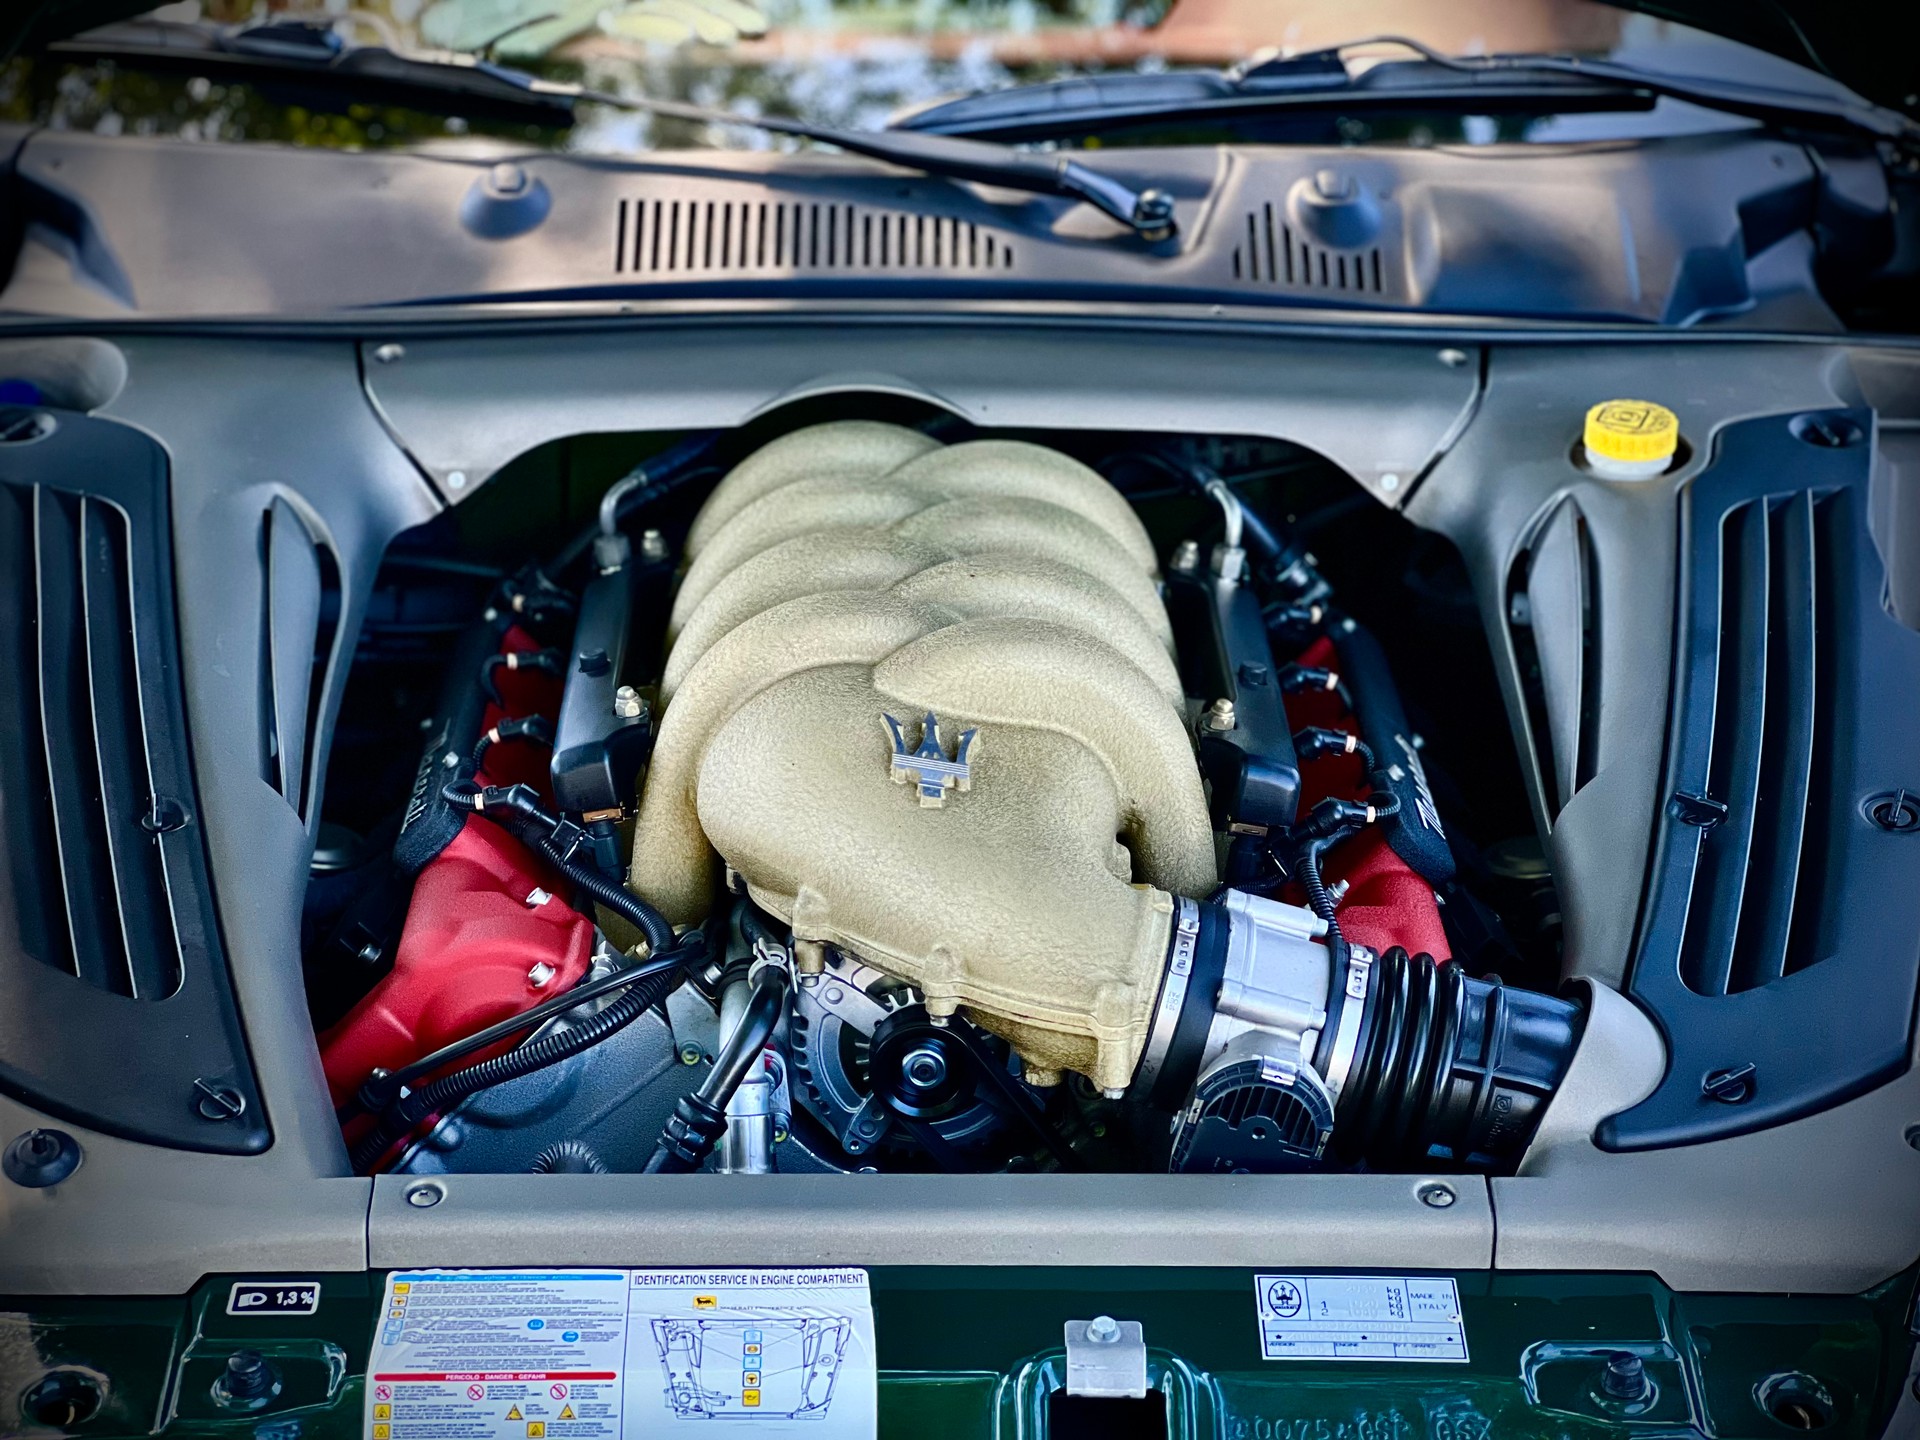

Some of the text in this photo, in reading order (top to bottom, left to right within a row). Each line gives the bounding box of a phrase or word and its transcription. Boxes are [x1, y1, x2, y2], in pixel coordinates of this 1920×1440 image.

[634, 1273, 864, 1286] IDENTIFICATION SERVICE IN ENGINE COMPARTMENT
[1386, 1286, 1401, 1296] kg
[276, 1291, 298, 1306] 1,3
[1387, 1294, 1402, 1303] kg
[1410, 1292, 1436, 1300] MADE
[1320, 1300, 1327, 1309] 1
[1388, 1301, 1403, 1311] kg
[1418, 1303, 1448, 1311] ITALY
[1321, 1308, 1329, 1316] 2
[1390, 1308, 1404, 1319] kg
